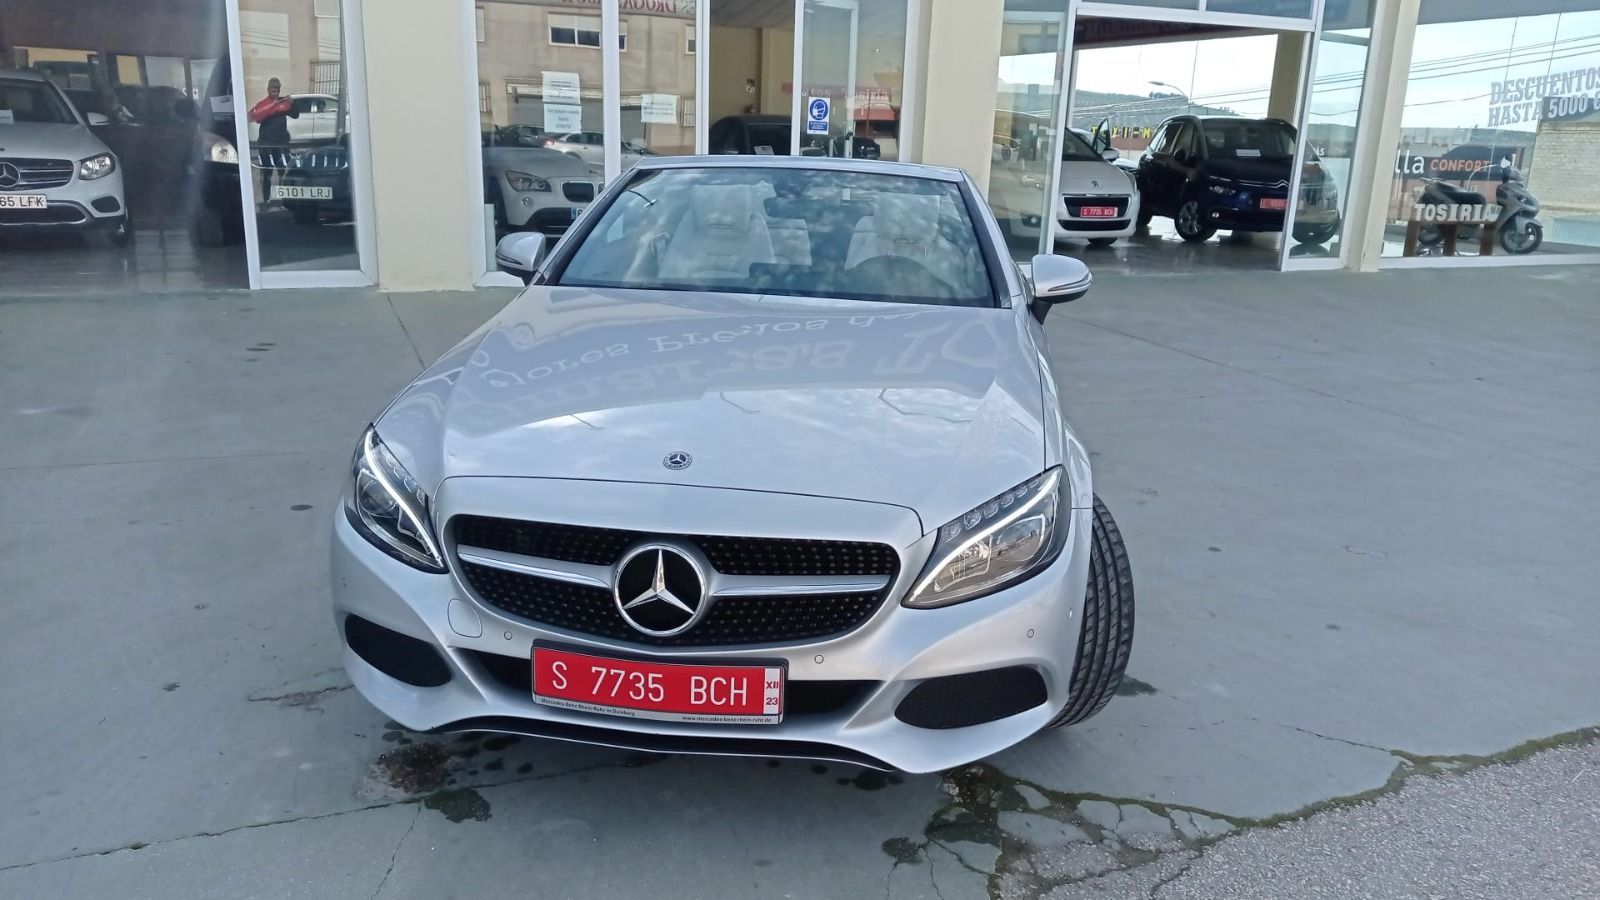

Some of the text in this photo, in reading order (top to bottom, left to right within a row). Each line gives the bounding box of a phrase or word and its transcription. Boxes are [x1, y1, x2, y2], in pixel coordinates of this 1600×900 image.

[1488, 100, 1543, 127] HASTA
[1547, 94, 1588, 119] 5000
[1430, 159, 1490, 173] CONFORT
[277, 187, 331, 198] 6101 LRJ
[19, 196, 44, 207] LFK
[552, 661, 747, 706] S 7735 BCH
[766, 697, 778, 706] 23
